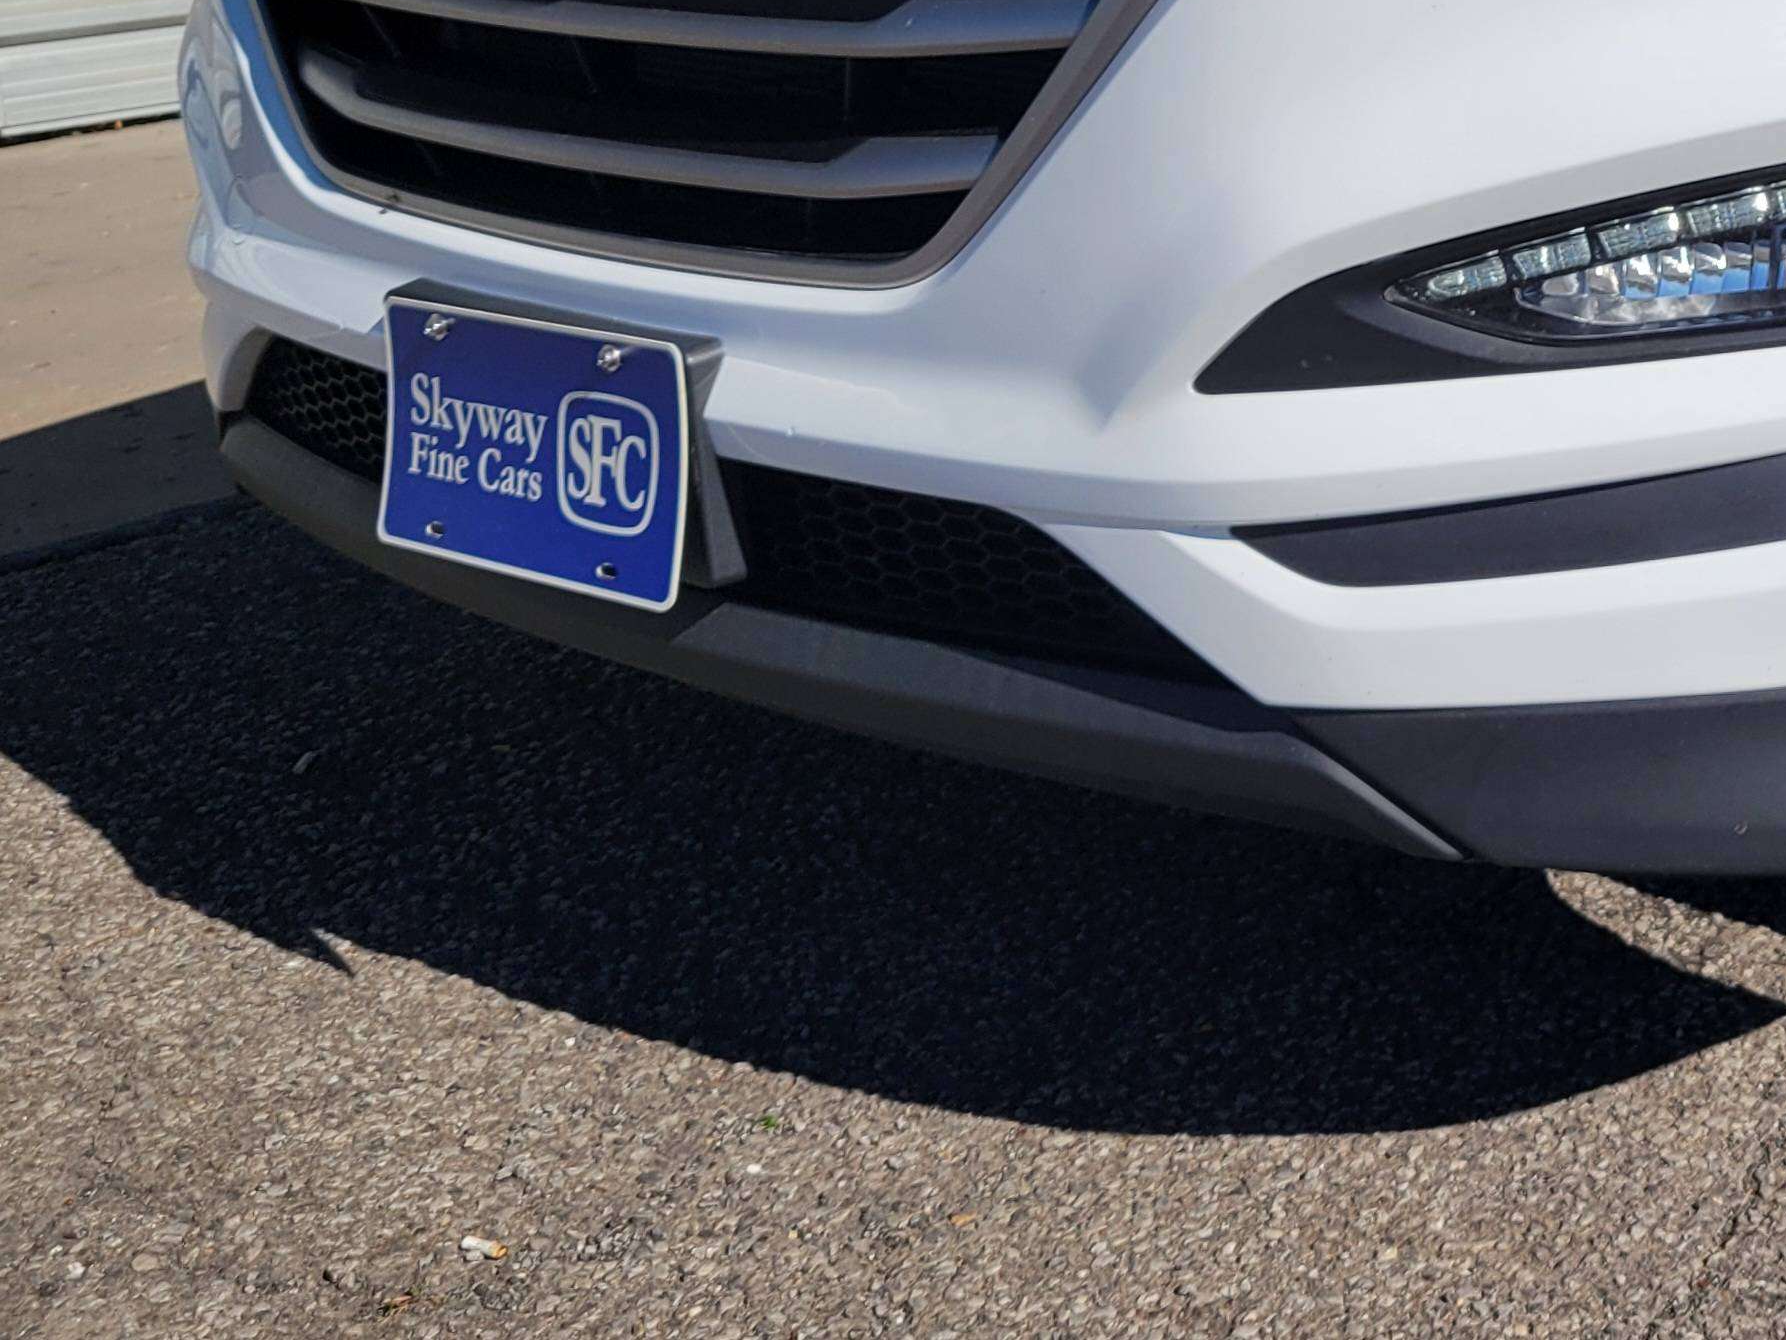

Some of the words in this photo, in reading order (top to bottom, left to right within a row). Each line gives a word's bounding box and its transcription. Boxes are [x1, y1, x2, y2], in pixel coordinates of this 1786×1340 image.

[409, 372, 549, 463] Skyway
[566, 413, 647, 511] SFC
[407, 431, 470, 485] Fine
[477, 447, 543, 502] Cars
